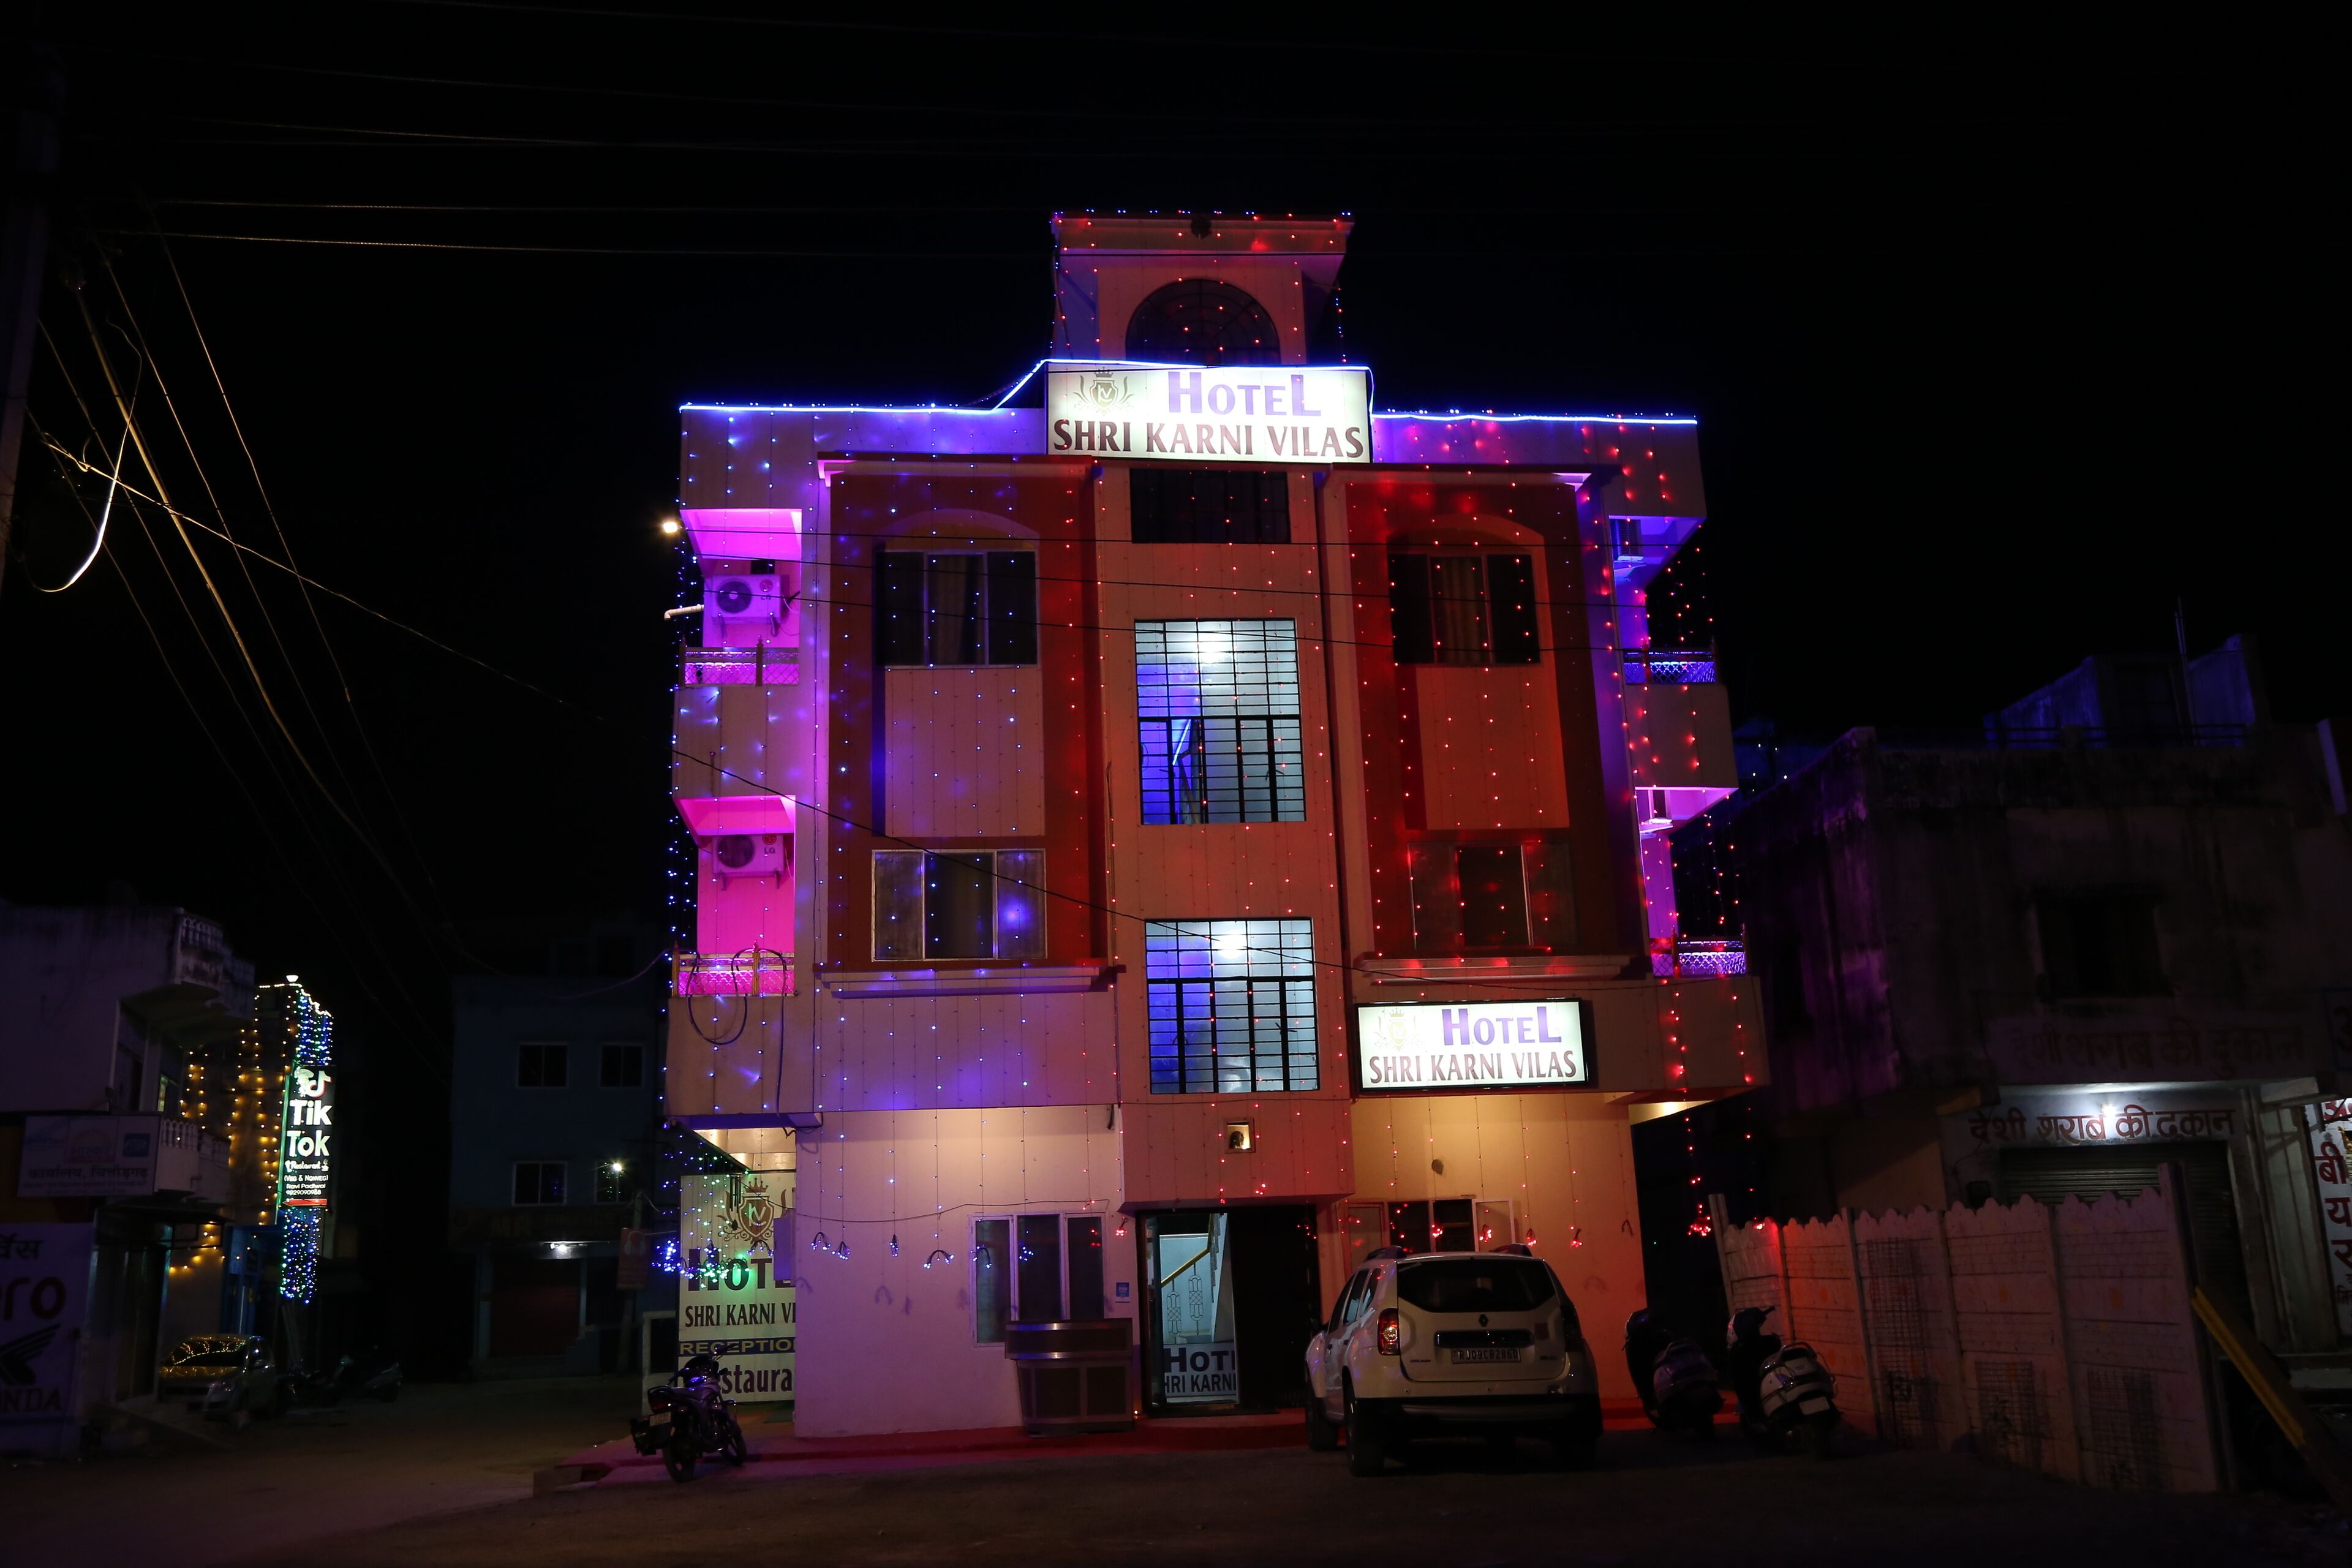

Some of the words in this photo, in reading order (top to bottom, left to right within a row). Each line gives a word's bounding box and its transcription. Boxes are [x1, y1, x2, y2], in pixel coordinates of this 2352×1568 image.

[1167, 371, 1321, 417] HOTEL
[1054, 419, 1131, 451] SHRI
[1146, 423, 1253, 455] KARNI
[1267, 426, 1363, 458] VILAS
[1442, 1006, 1562, 1046] HOTEL
[1369, 1055, 1422, 1084] SHRI
[1431, 1053, 1503, 1081] KARNI
[1511, 1050, 1576, 1079] VILAS
[290, 1099, 333, 1126] Tik
[2037, 1115, 2107, 1144] शराब
[2115, 1104, 2154, 1138] की
[287, 1130, 330, 1157] Tok
[688, 1248, 796, 1291] HOT
[0, 1276, 66, 1321] ro
[685, 1305, 720, 1327] SHRI
[726, 1303, 775, 1325] KARNI
[679, 1338, 795, 1354] RECEPTIO
[1164, 1348, 1236, 1372] HOT
[722, 1365, 793, 1393] staura
[1164, 1375, 1185, 1393] HRI
[1191, 1374, 1236, 1392] KARNI
[0, 1387, 61, 1412] NDA
